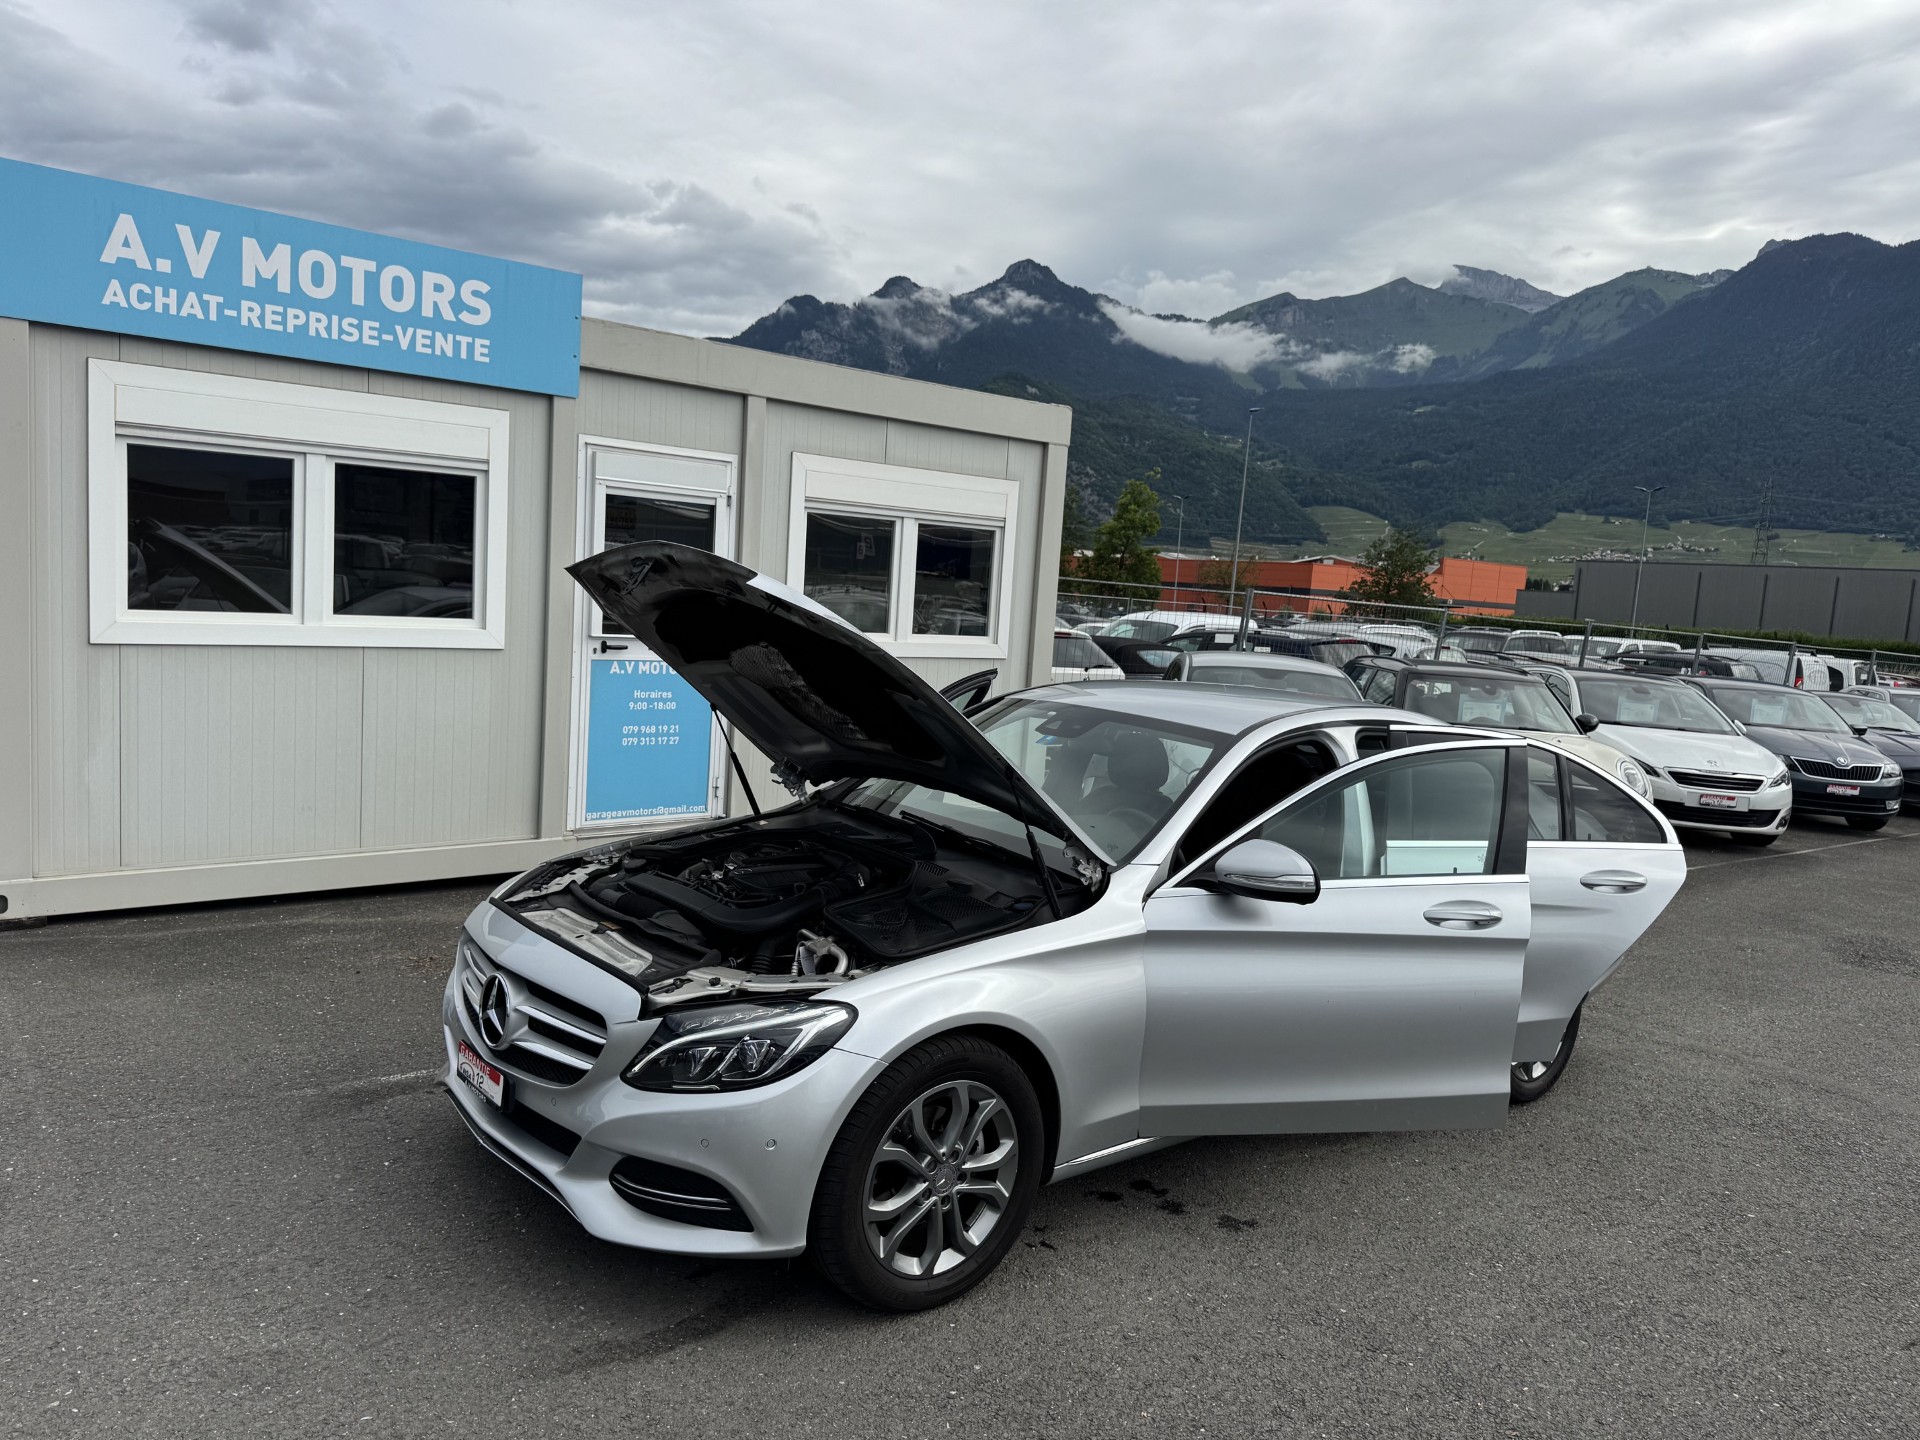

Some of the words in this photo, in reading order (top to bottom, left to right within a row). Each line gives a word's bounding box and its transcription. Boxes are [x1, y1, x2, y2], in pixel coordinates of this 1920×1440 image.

[100, 213, 221, 279] A.V
[241, 236, 492, 326] MOTORS
[101, 278, 491, 363] ACHAT-REPRISE-VENTE
[609, 661, 635, 675] A.V
[638, 661, 677, 675] MOT
[634, 689, 672, 699] Horaires
[629, 701, 647, 710] 9:00
[622, 725, 638, 734] 079
[640, 725, 656, 734] 968
[658, 724, 668, 733] 19
[669, 724, 679, 733] 21
[622, 737, 638, 746] 079
[640, 737, 655, 746] 313
[658, 736, 667, 745] 17
[669, 736, 679, 745] 27
[586, 804, 706, 820] garageavmotors@gmail.com
[460, 1045, 491, 1078] GARANTIE
[475, 1072, 485, 1090] 12
